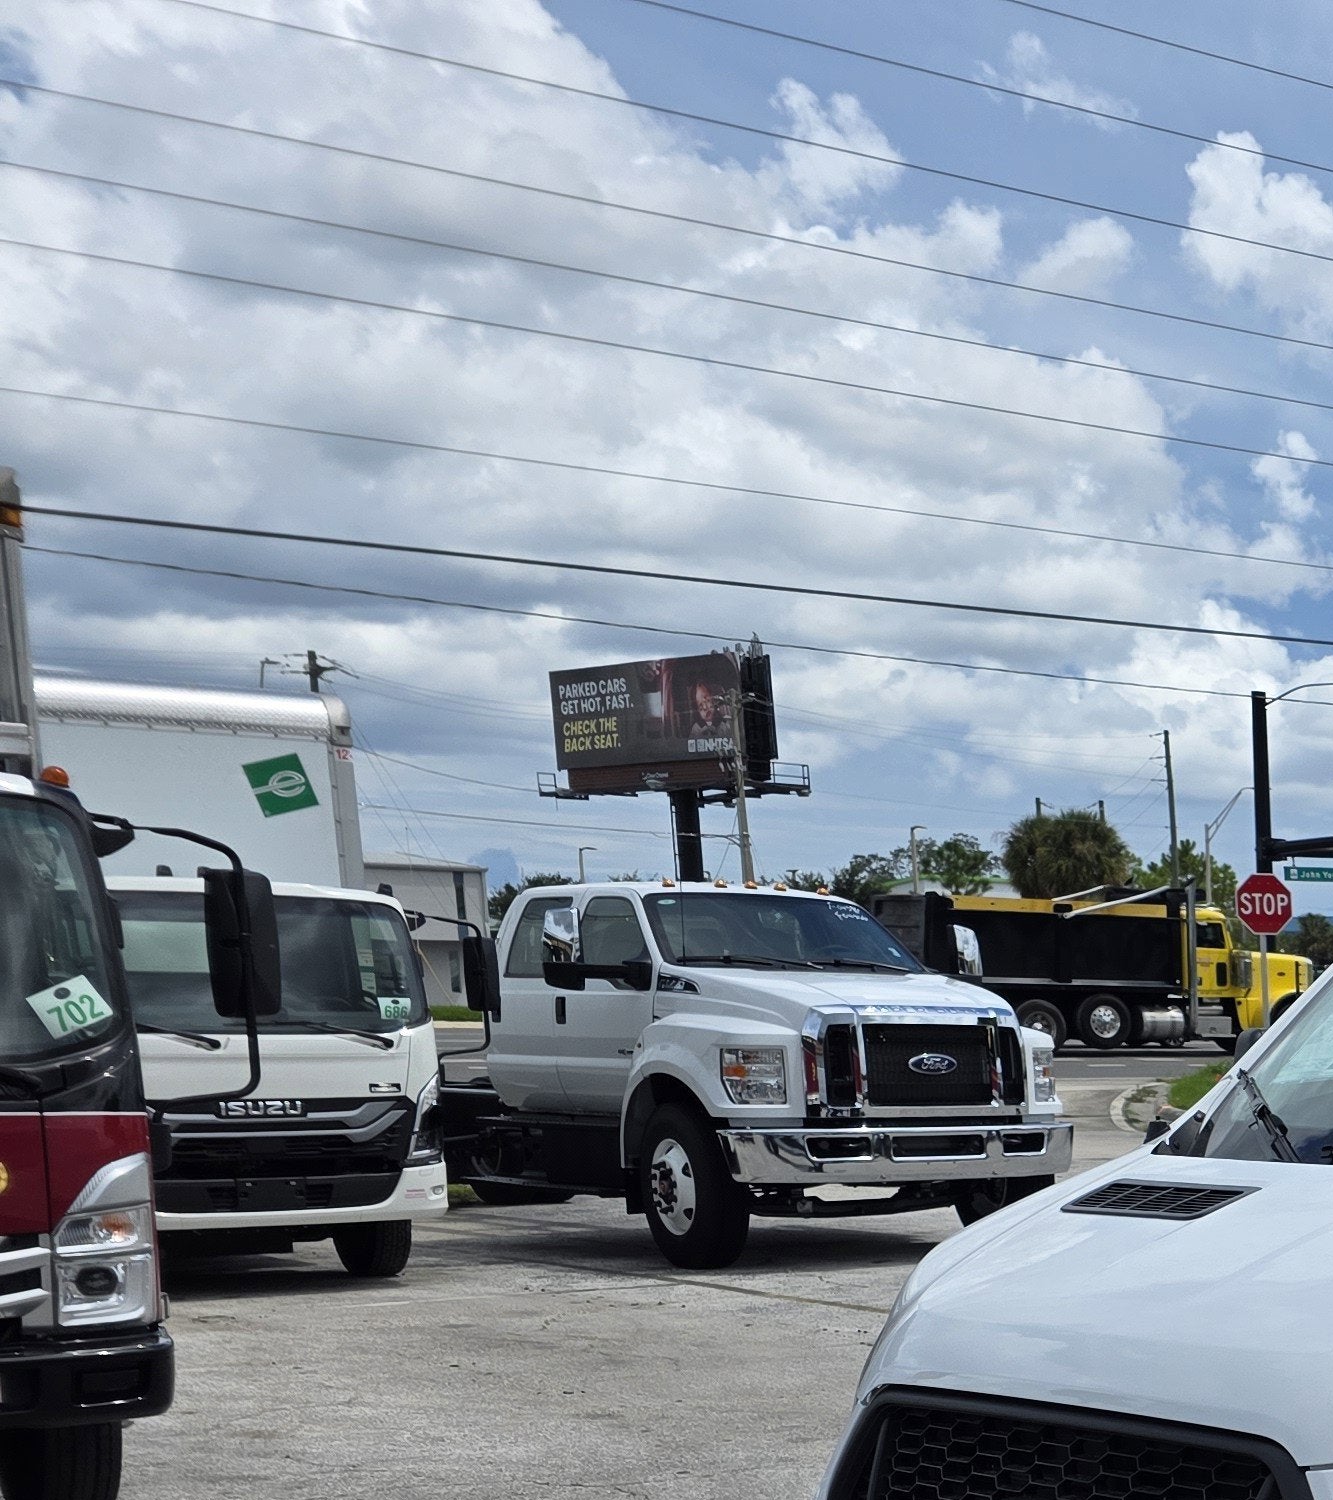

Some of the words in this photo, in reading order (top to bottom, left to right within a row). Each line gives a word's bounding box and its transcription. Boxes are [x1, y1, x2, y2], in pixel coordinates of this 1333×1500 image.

[558, 681, 597, 699] PARKED
[599, 677, 627, 694] CARS
[560, 701, 579, 715] GET
[580, 697, 604, 714] HOT,
[606, 693, 634, 709] FAST.
[563, 720, 597, 736] CHECK
[599, 716, 618, 733] THE
[564, 736, 592, 753] BACK
[593, 733, 621, 750] SEAT.
[1300, 870, 1321, 879] John
[1240, 892, 1289, 916] STOP
[46, 994, 105, 1032] 702
[384, 1005, 408, 1019] 686
[921, 1057, 949, 1070] Ford
[219, 1100, 302, 1117] ISUZU
